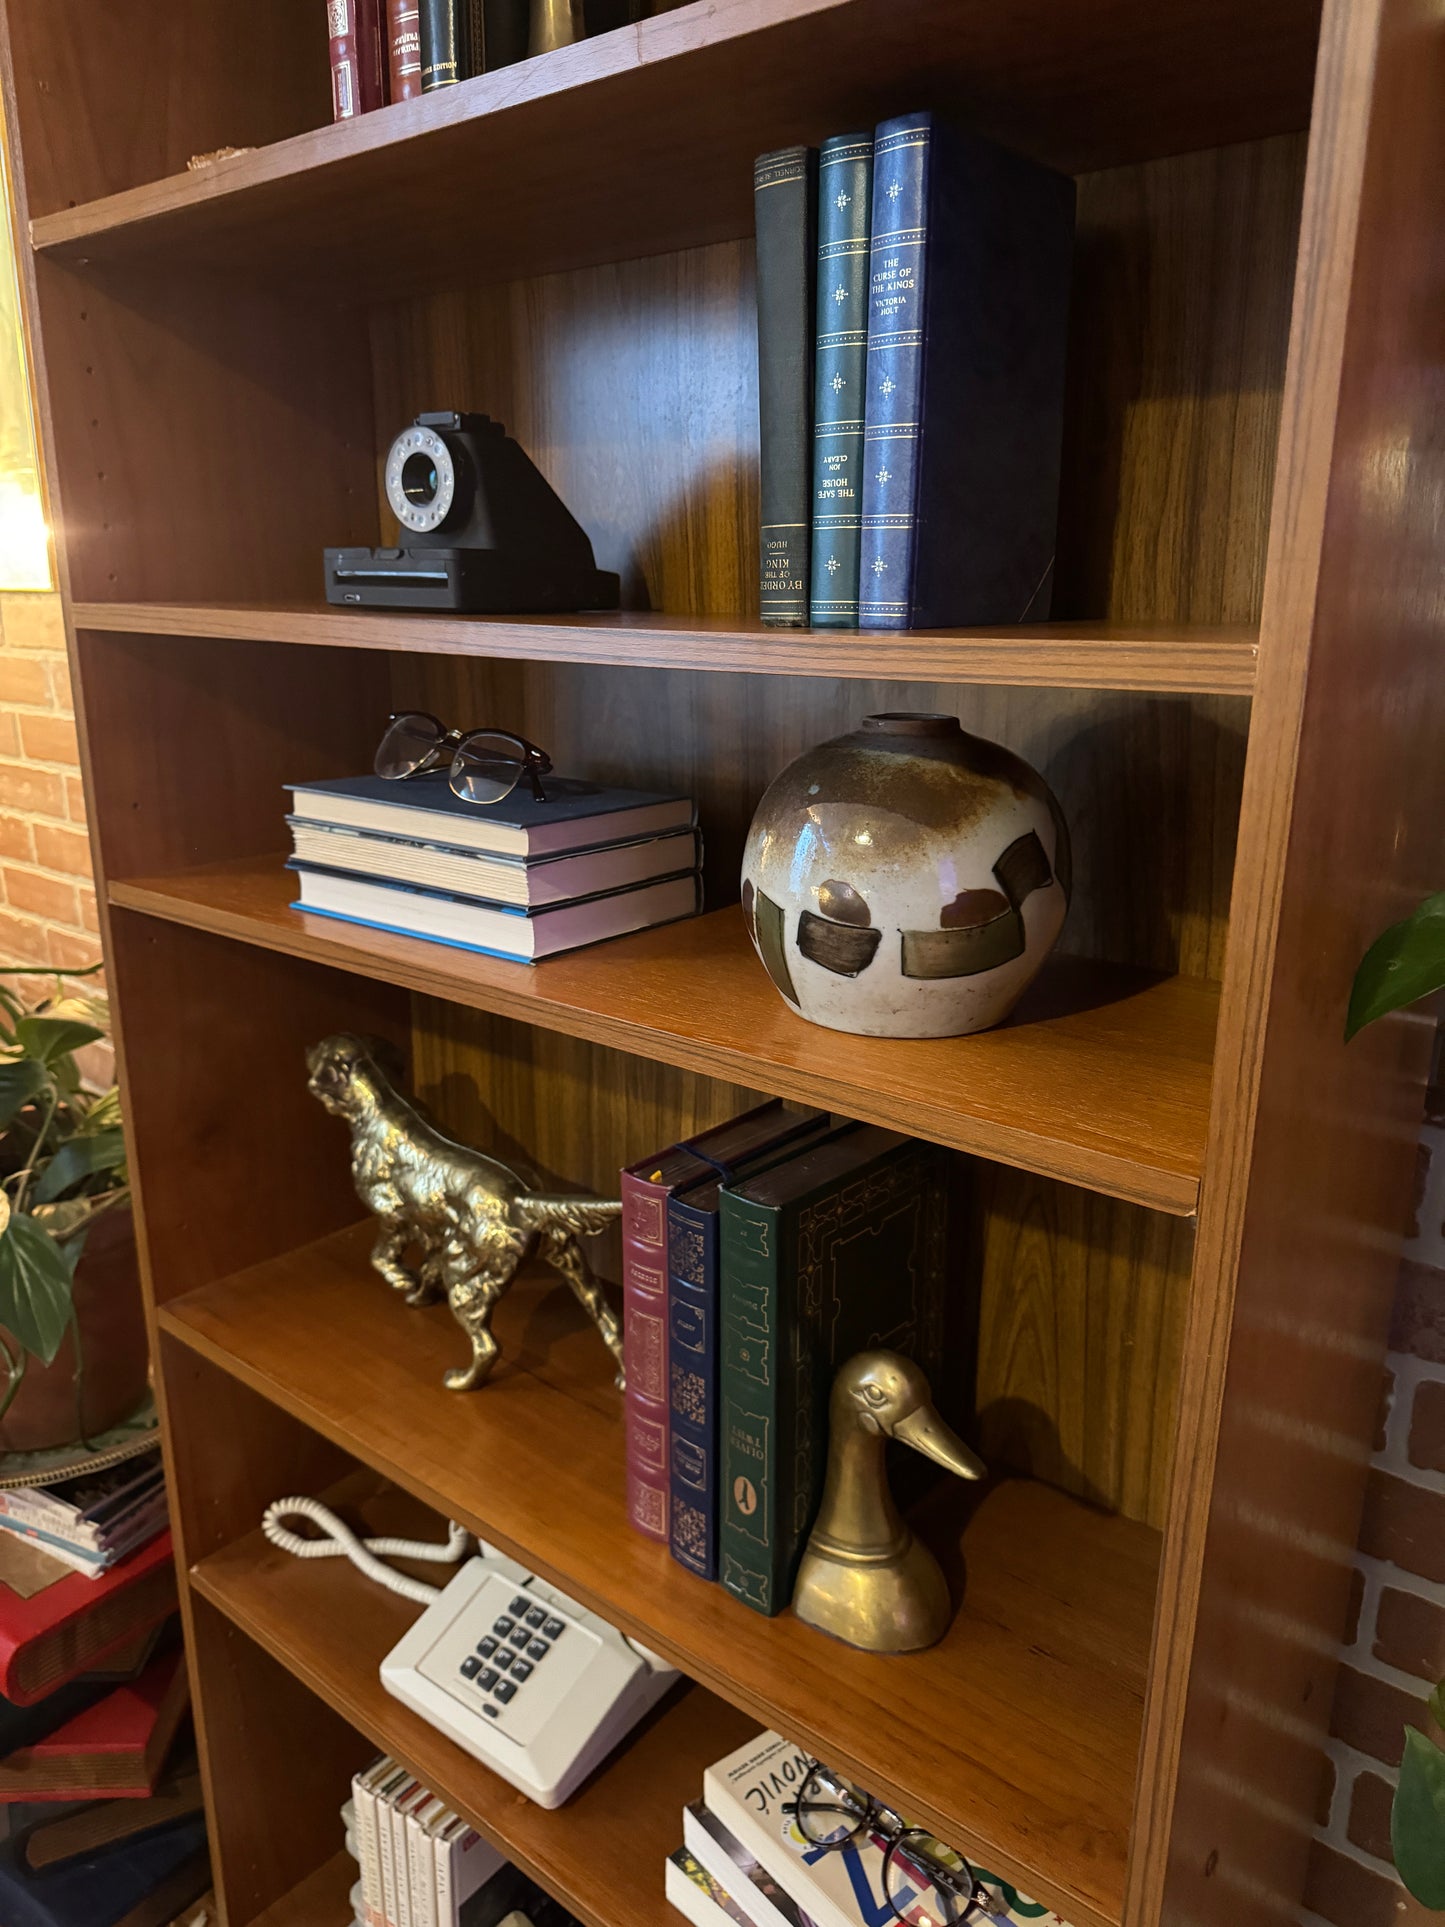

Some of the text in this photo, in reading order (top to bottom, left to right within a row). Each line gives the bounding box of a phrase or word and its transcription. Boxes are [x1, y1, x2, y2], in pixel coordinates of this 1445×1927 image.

[884, 257, 899, 268] THE
[873, 267, 912, 282] CURSE OF
[872, 279, 915, 295] THE KINGS
[875, 296, 907, 307] VICTORIA
[880, 306, 899, 316] HOLT
[823, 454, 848, 464] CLEARY
[828, 463, 841, 471] JON
[822, 478, 848, 488] HOUSE
[817, 488, 855, 499] THE SAFE
[766, 540, 788, 549] HUGO
[766, 558, 789, 569] KING
[764, 570, 790, 579] OF THE
[787, 580, 803, 590] BY
